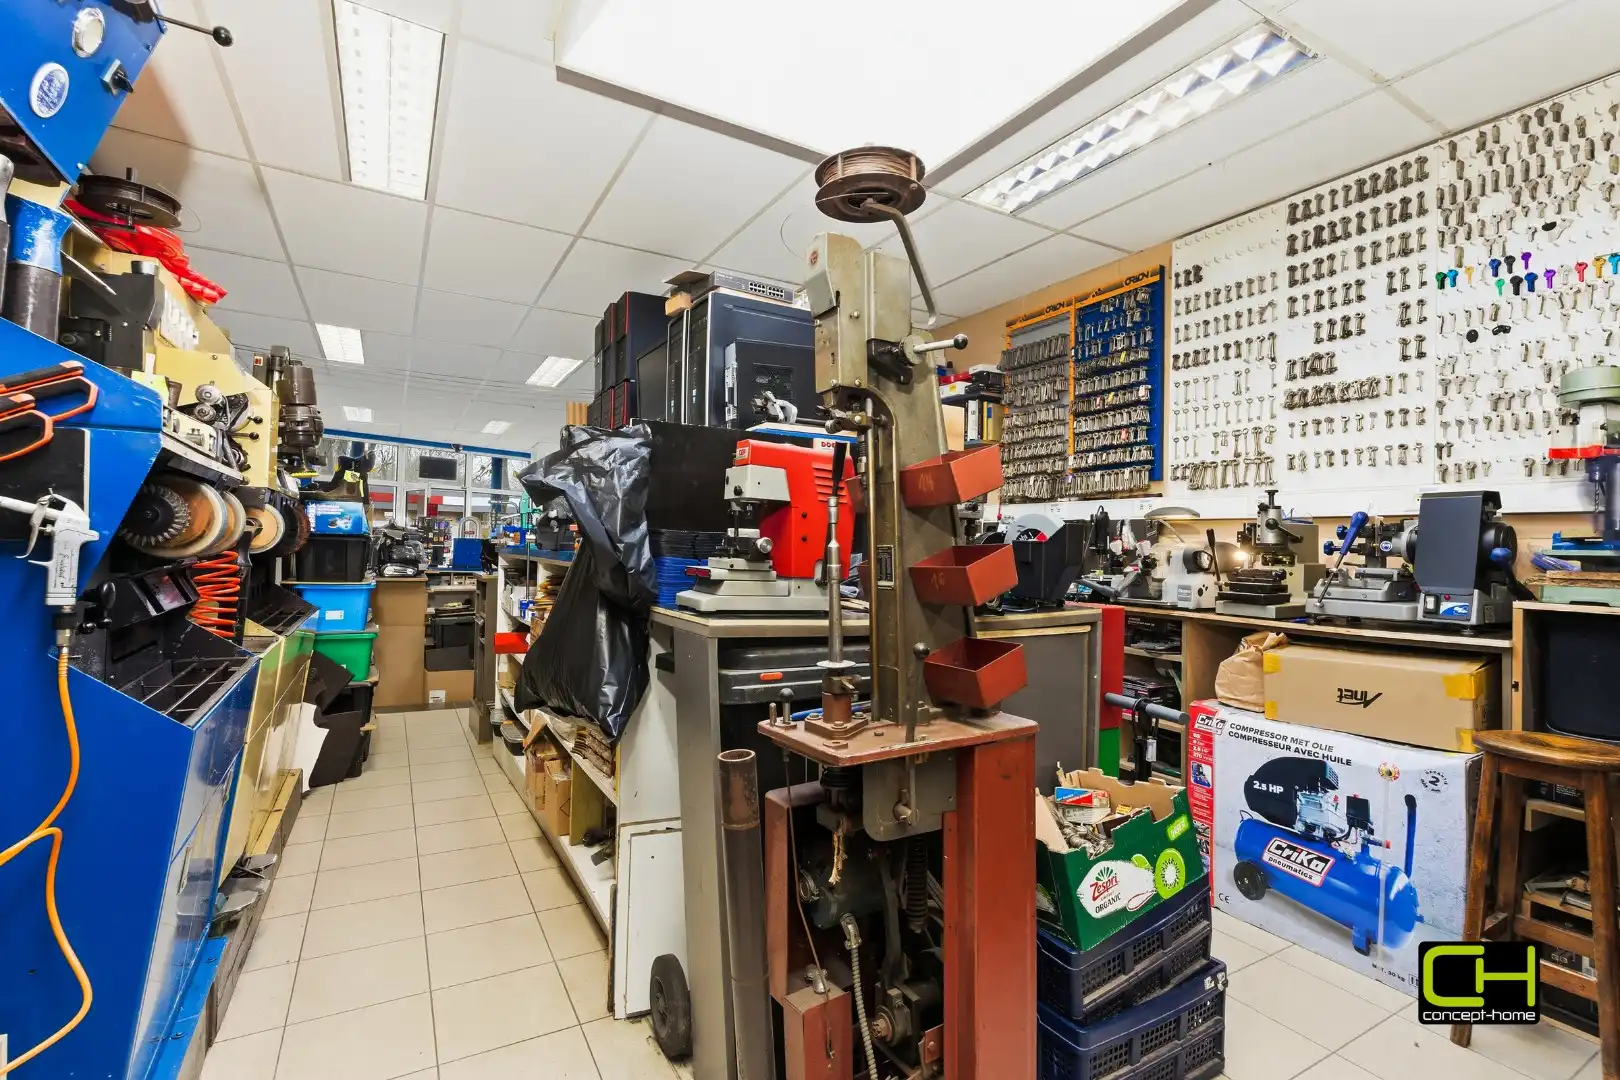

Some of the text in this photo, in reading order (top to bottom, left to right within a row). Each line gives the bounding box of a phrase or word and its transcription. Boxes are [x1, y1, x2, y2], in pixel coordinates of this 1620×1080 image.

[1228, 730, 1292, 752] COMPRESSEUR
[1294, 746, 1320, 759] AVEC
[1322, 754, 1352, 766] HUILE
[1229, 722, 1289, 742] COMPRESSOR
[1290, 736, 1310, 746] MET
[1312, 742, 1334, 752] OLIE
[1253, 780, 1284, 794] 2.5 HP
[1268, 856, 1313, 880] pneumatics
[1090, 873, 1119, 902] Zespri
[1095, 892, 1121, 914] ORGANIC
